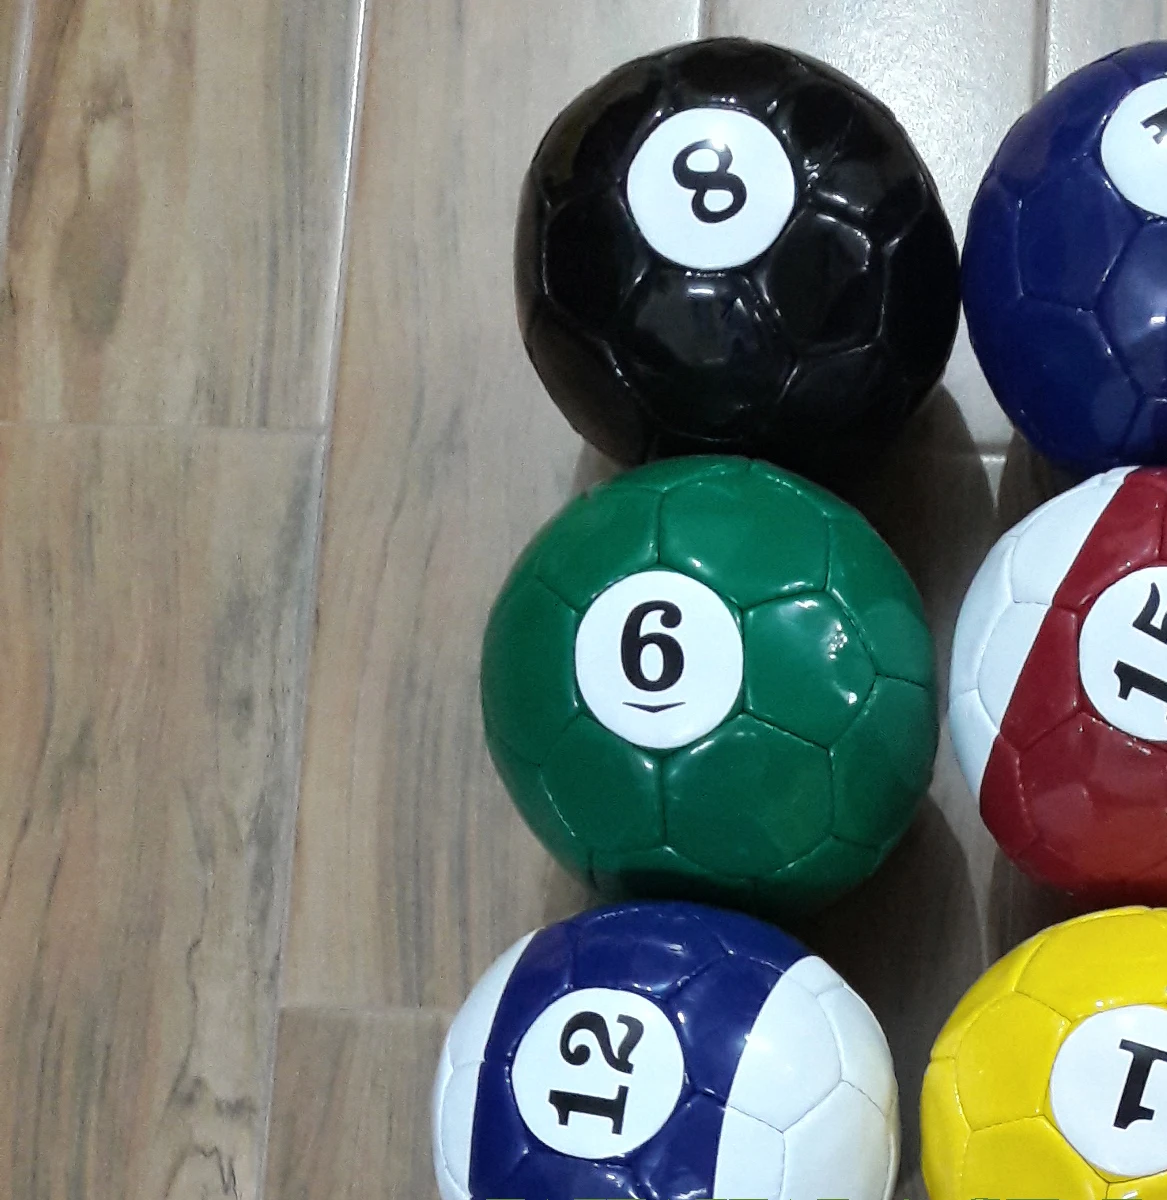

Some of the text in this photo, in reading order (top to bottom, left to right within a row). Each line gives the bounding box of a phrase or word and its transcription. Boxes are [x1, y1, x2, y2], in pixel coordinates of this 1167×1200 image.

[673, 137, 747, 224] 8
[621, 601, 685, 692] 6
[549, 1012, 644, 1135] 12
